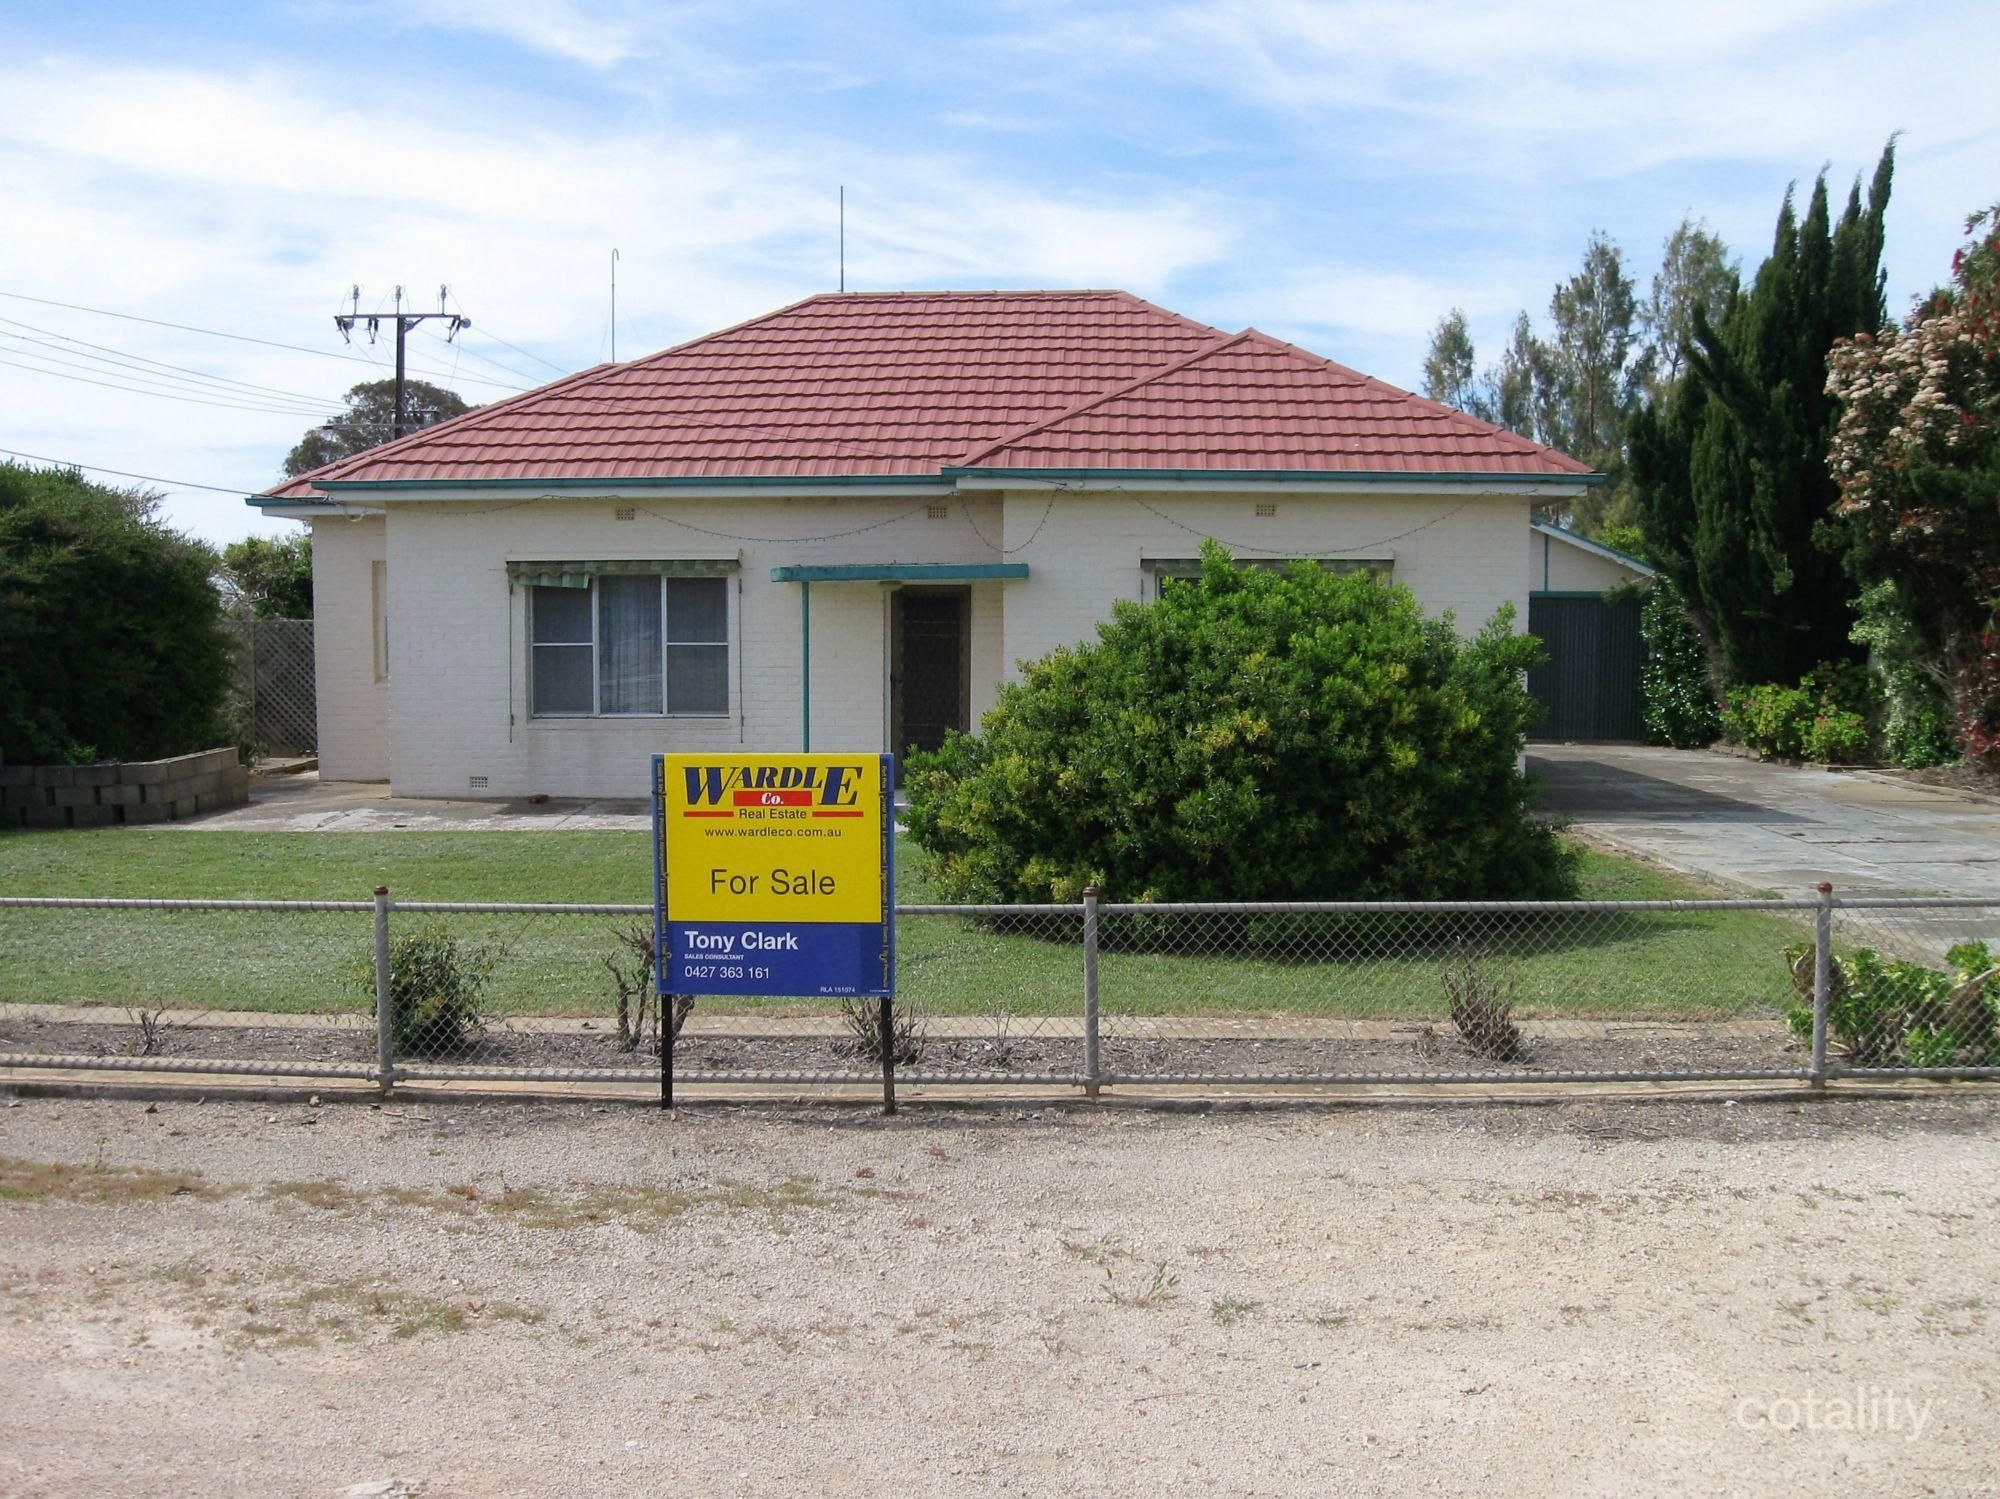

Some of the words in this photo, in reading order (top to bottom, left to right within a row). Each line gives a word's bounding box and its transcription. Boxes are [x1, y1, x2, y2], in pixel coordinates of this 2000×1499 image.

[683, 766, 863, 805] WARDLE
[761, 792, 784, 805] Co.
[739, 808, 765, 819] Real
[770, 808, 807, 819] Estate
[705, 827, 842, 838] www.wardleco.com.au
[711, 869, 759, 895] For
[771, 869, 836, 895] Sale
[684, 930, 735, 953] Tony
[741, 931, 799, 950] Clark
[684, 966, 716, 978] 0427
[720, 966, 743, 979] 363
[748, 967, 769, 979] 161
